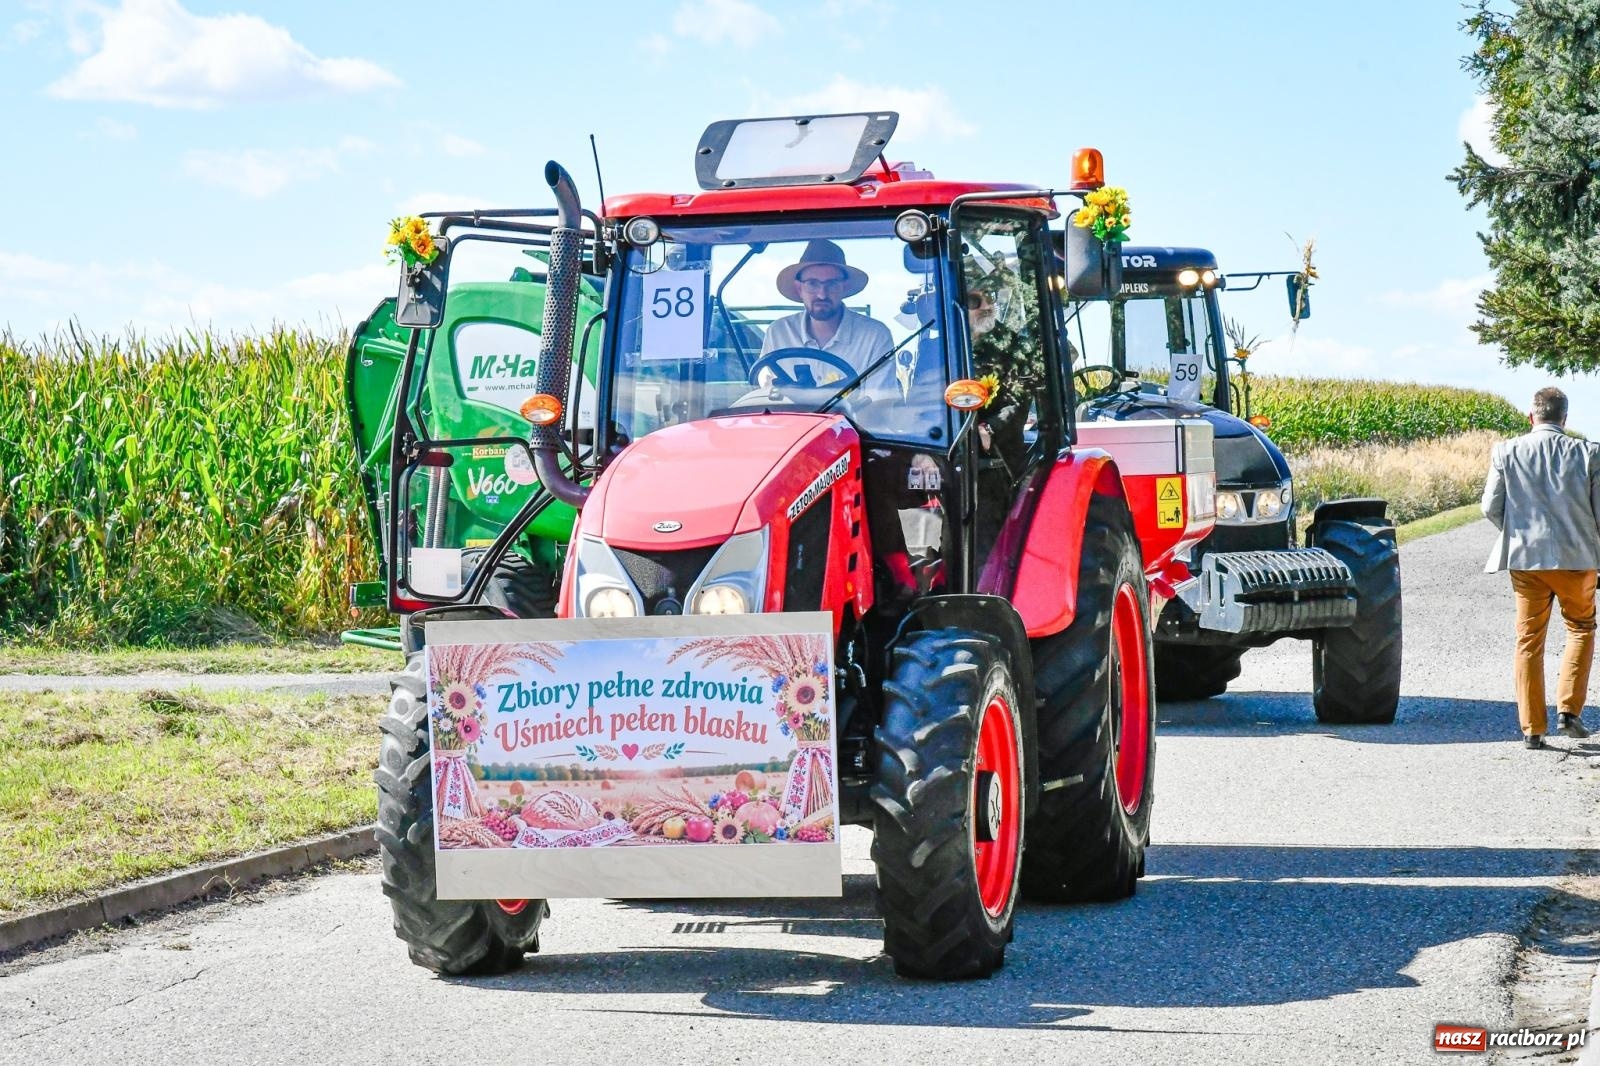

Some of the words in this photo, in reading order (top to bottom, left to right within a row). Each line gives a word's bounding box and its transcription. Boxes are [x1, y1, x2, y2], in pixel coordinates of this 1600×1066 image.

[1121, 254, 1157, 268] TOR
[652, 286, 695, 319] 58
[1120, 283, 1149, 293] MPLEKS
[469, 354, 538, 379] McHa
[1174, 363, 1198, 382] 59
[790, 488, 814, 519] ZETOR
[814, 469, 833, 494] MAJOR
[498, 680, 580, 713] Zbiory
[588, 670, 654, 708] pełne
[661, 671, 763, 705] zdrowia
[494, 706, 604, 753] Uśmiech
[610, 703, 677, 741] pełen
[683, 705, 768, 745] blasku
